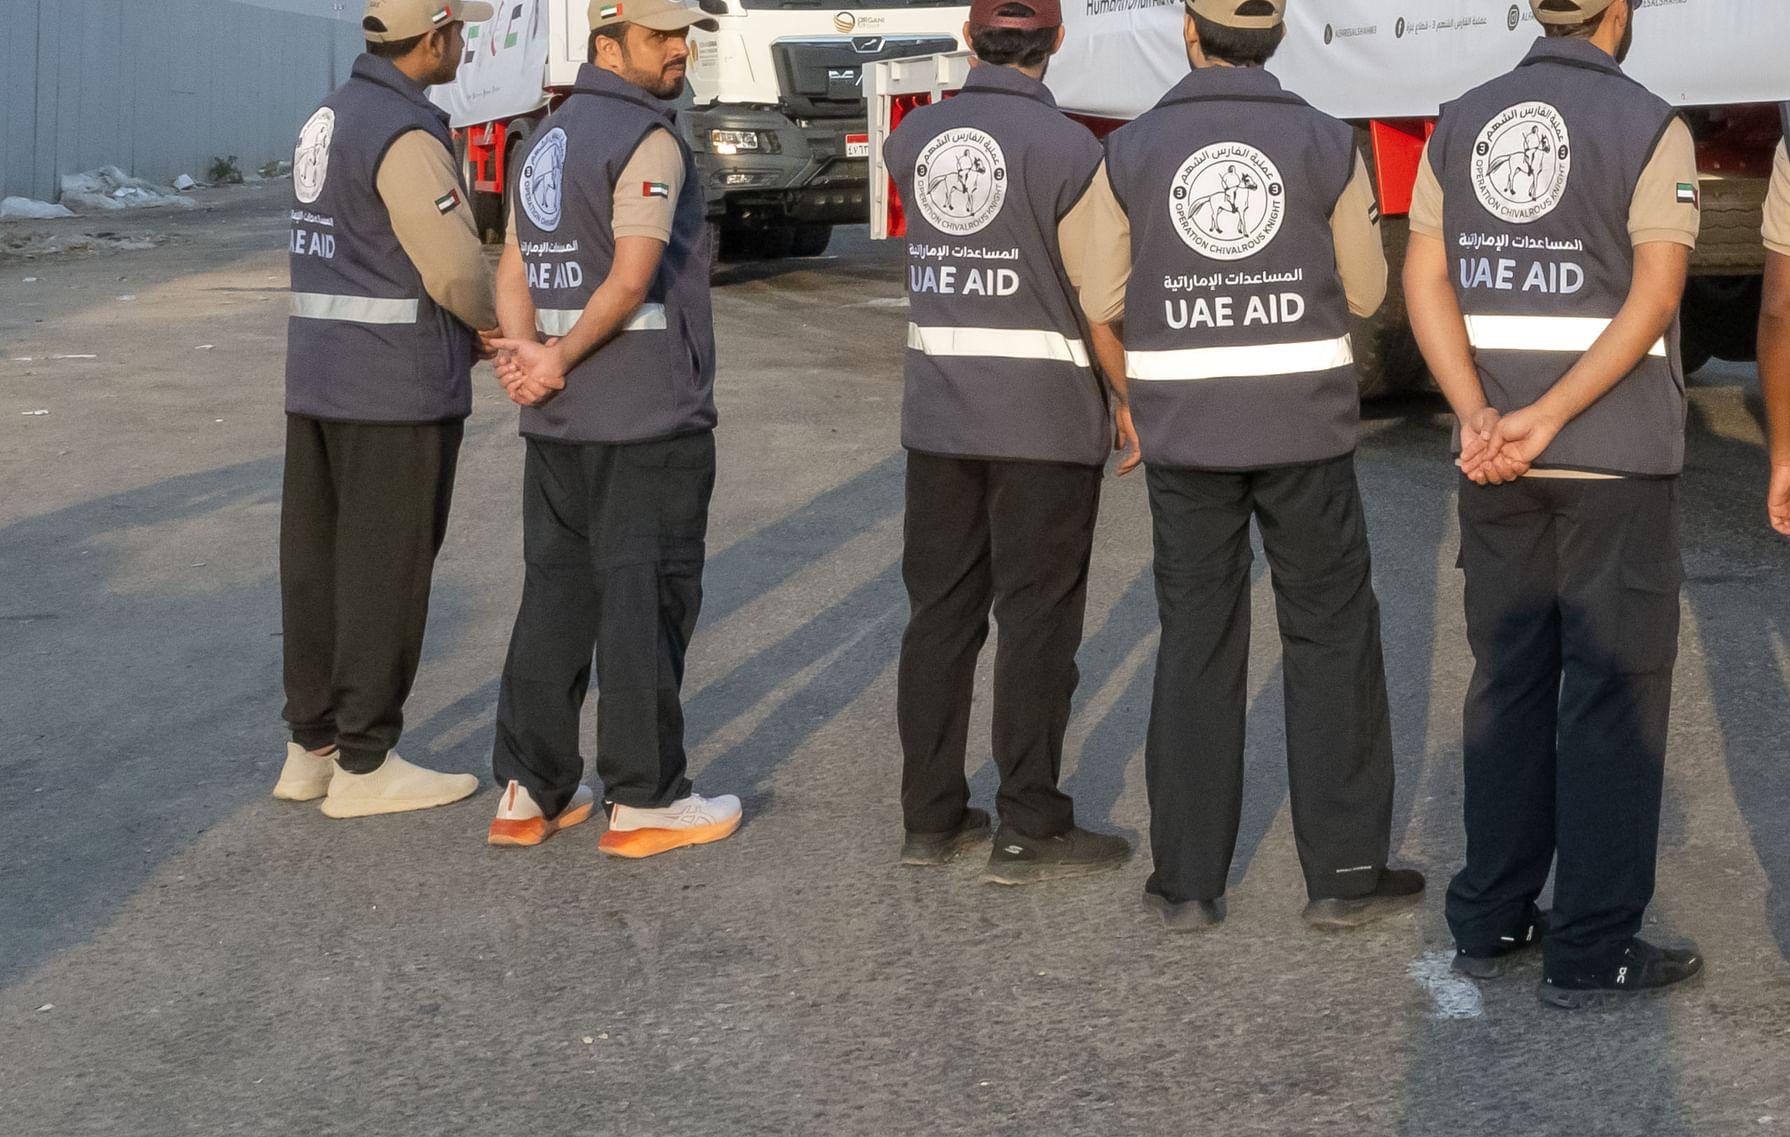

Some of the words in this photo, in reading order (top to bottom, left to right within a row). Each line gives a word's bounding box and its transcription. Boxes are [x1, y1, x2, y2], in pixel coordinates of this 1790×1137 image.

[1486, 108, 1518, 143] الشهم
[1519, 105, 1550, 123] الفارس
[1549, 113, 1564, 143] عملية
[1211, 145, 1250, 160] الفارس
[1250, 152, 1274, 181] عملية
[1180, 150, 1210, 186] الشهم
[1476, 159, 1501, 211] OPERATION
[1500, 199, 1553, 219] CHIVALROUS
[1551, 164, 1566, 201] KNIGHT
[917, 179, 942, 225] OPERATION
[941, 214, 989, 232] CHIVALROUS
[986, 184, 1003, 216] KNIGHT
[1175, 202, 1209, 250] OPERATION
[1209, 233, 1266, 255] CHIVALROUS
[1264, 200, 1281, 235] KNIGHT
[1458, 232, 1509, 252] الإماراتية
[308, 231, 336, 259] AID
[908, 243, 950, 261] الإماراتية
[951, 245, 1019, 260] المساعدات
[1511, 235, 1583, 251] المساعدات
[553, 260, 583, 289] AID
[910, 264, 957, 294] UAE
[962, 268, 1020, 296] AID
[1163, 272, 1222, 292] الإماراتية
[1224, 268, 1303, 286] المساعدات
[1459, 257, 1516, 290] UAE
[1521, 260, 1585, 294] AID
[1165, 296, 1234, 330] UAE
[1243, 292, 1305, 326] AID
